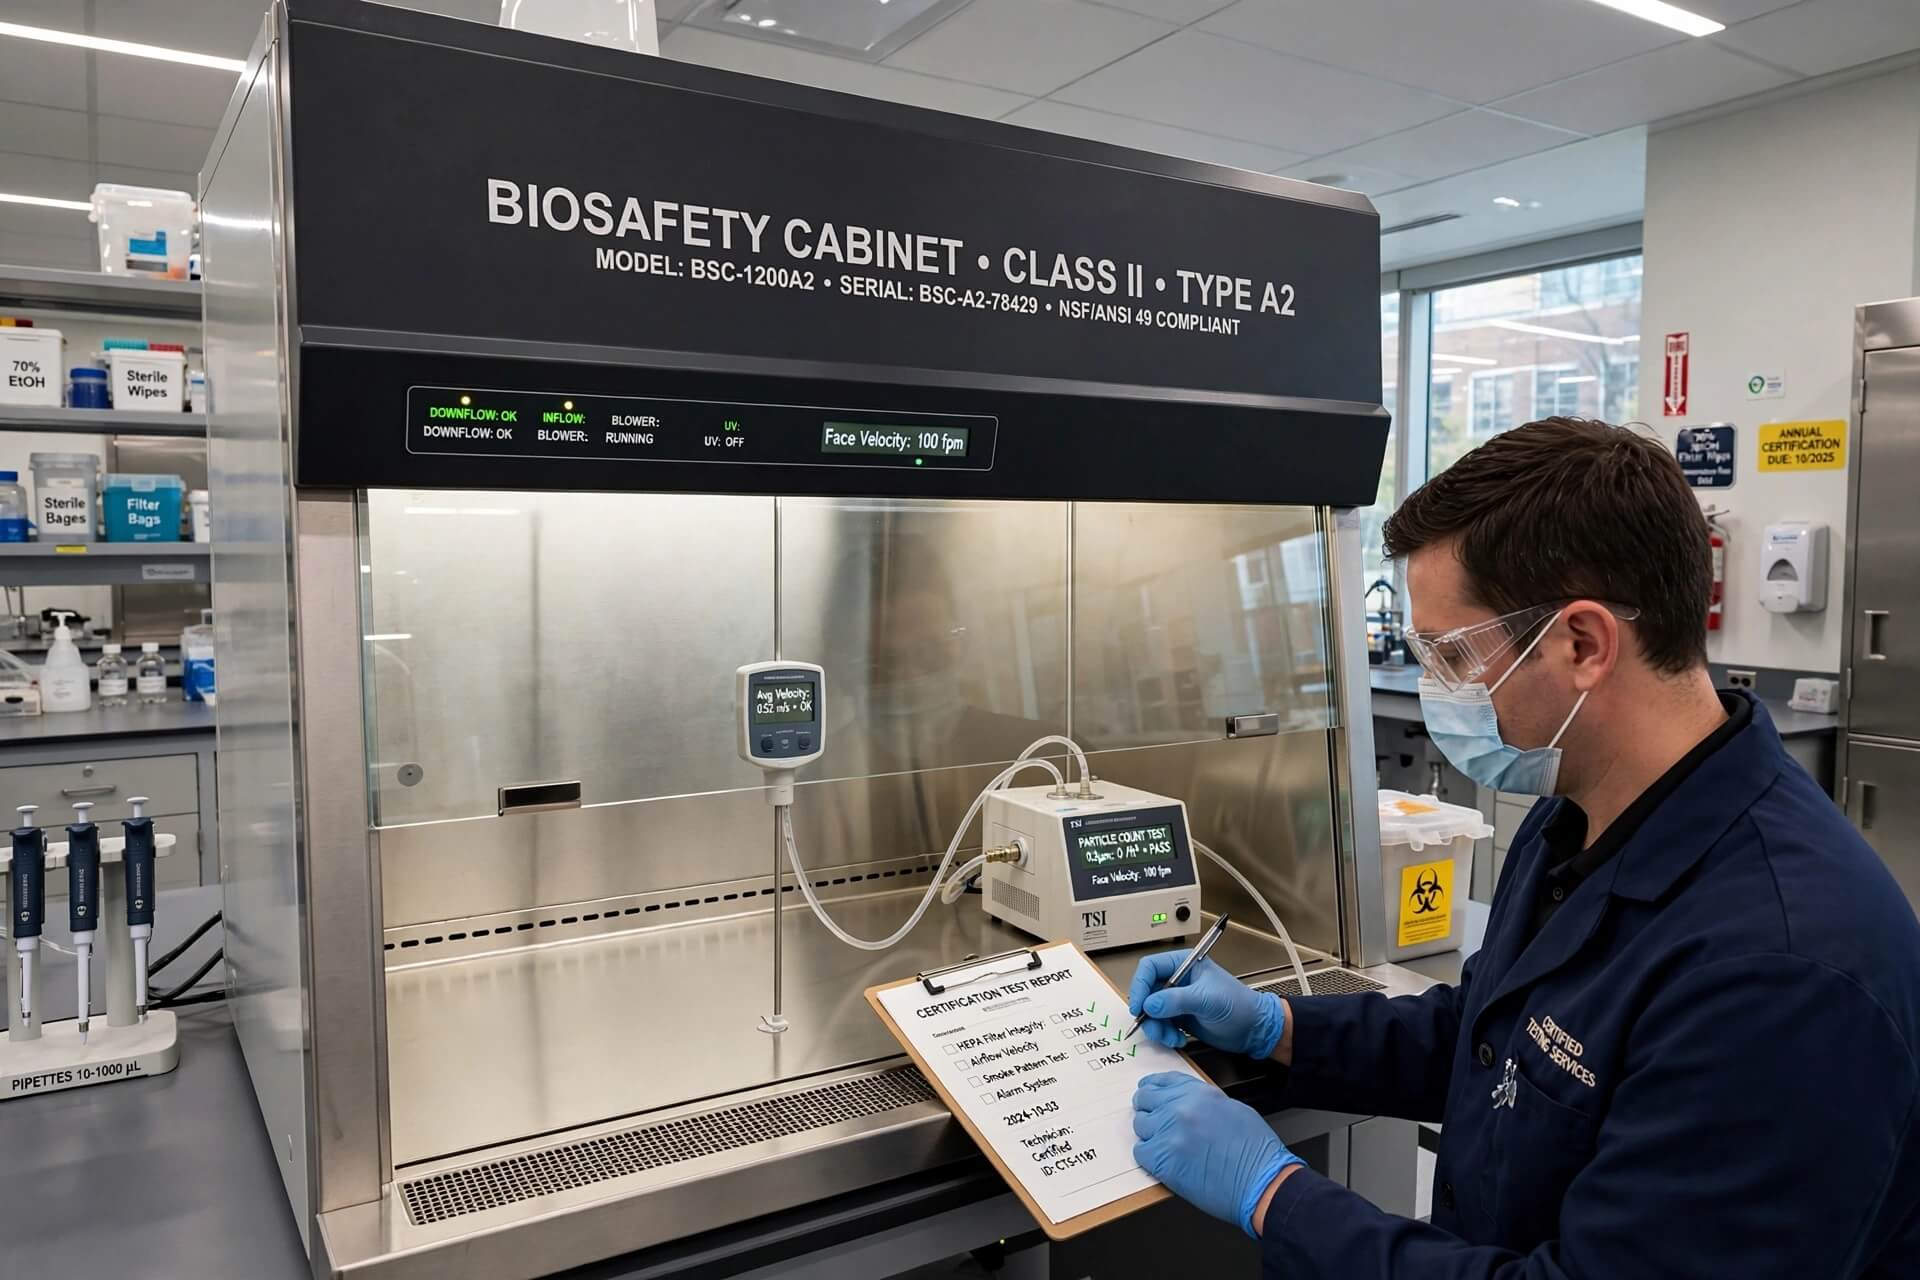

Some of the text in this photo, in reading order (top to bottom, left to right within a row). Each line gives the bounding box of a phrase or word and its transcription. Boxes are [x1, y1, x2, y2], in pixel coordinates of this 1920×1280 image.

[487, 178, 1296, 316] BIOSAFETY CABINET CLASS II TYPE A2
[596, 247, 1240, 336] MODEL: BSC-1200A2 SERIAL: BSC-A2-78429 NSF/ANSI 49 COMPLIANT
[12, 360, 41, 373] 70%
[9, 375, 45, 388] EtOH
[127, 369, 168, 383] Sterile
[127, 385, 168, 400] Wipes
[430, 407, 518, 422] DOWNFLOW: OK
[543, 412, 586, 424] INFLOW:
[611, 415, 660, 428] BLOWER:
[423, 425, 512, 440] DOWNFLOW: OK
[724, 420, 741, 432] UV:
[1779, 426, 1822, 438] ANNUAL
[537, 430, 589, 443] BLOWER:
[606, 432, 653, 445] RUNNING
[704, 436, 745, 448] UV: OFF
[825, 428, 964, 454] Face Velocity: 100 fpm
[1762, 438, 1840, 453] CERTIFICATION
[1768, 452, 1835, 465] DUE: 10/2025
[44, 496, 85, 510] Sterile
[127, 498, 160, 511] Filter
[46, 512, 86, 527] Bages
[128, 513, 161, 527] Bags
[757, 688, 809, 703] Avg Velocity:
[800, 700, 813, 712] OK
[1078, 828, 1166, 848] PARTICLE COUNT TEST
[1117, 848, 1124, 858] 0
[1150, 842, 1171, 854] PASS
[1143, 866, 1157, 878] 100
[1082, 911, 1107, 928] TSI
[916, 986, 1002, 1020] CERTIFICATION
[1002, 979, 1030, 998] TEST
[1032, 969, 1074, 989] REPORT
[1061, 1007, 1084, 1022] PASS
[956, 1037, 982, 1052] HEPA
[983, 1029, 1008, 1044] Filter
[1008, 1018, 1047, 1038] Integrity:
[1073, 1022, 1097, 1037] PASS
[1087, 1037, 1111, 1052] PASS
[970, 1040, 1040, 1068] Airflow Velocity
[1100, 1052, 1125, 1067] PASS
[983, 1051, 1069, 1085] Smoke Pattern Test:
[1549, 1045, 1596, 1088] SERVICES
[12, 1060, 142, 1091] PIPETTES 10-1000 µL
[996, 1075, 1058, 1101] Alarm System
[1003, 1100, 1060, 1127] 2024-10-03
[1020, 1126, 1075, 1149] Technician:
[1031, 1140, 1073, 1163] Certified
[1040, 1148, 1098, 1177] ID: CTS-1187
